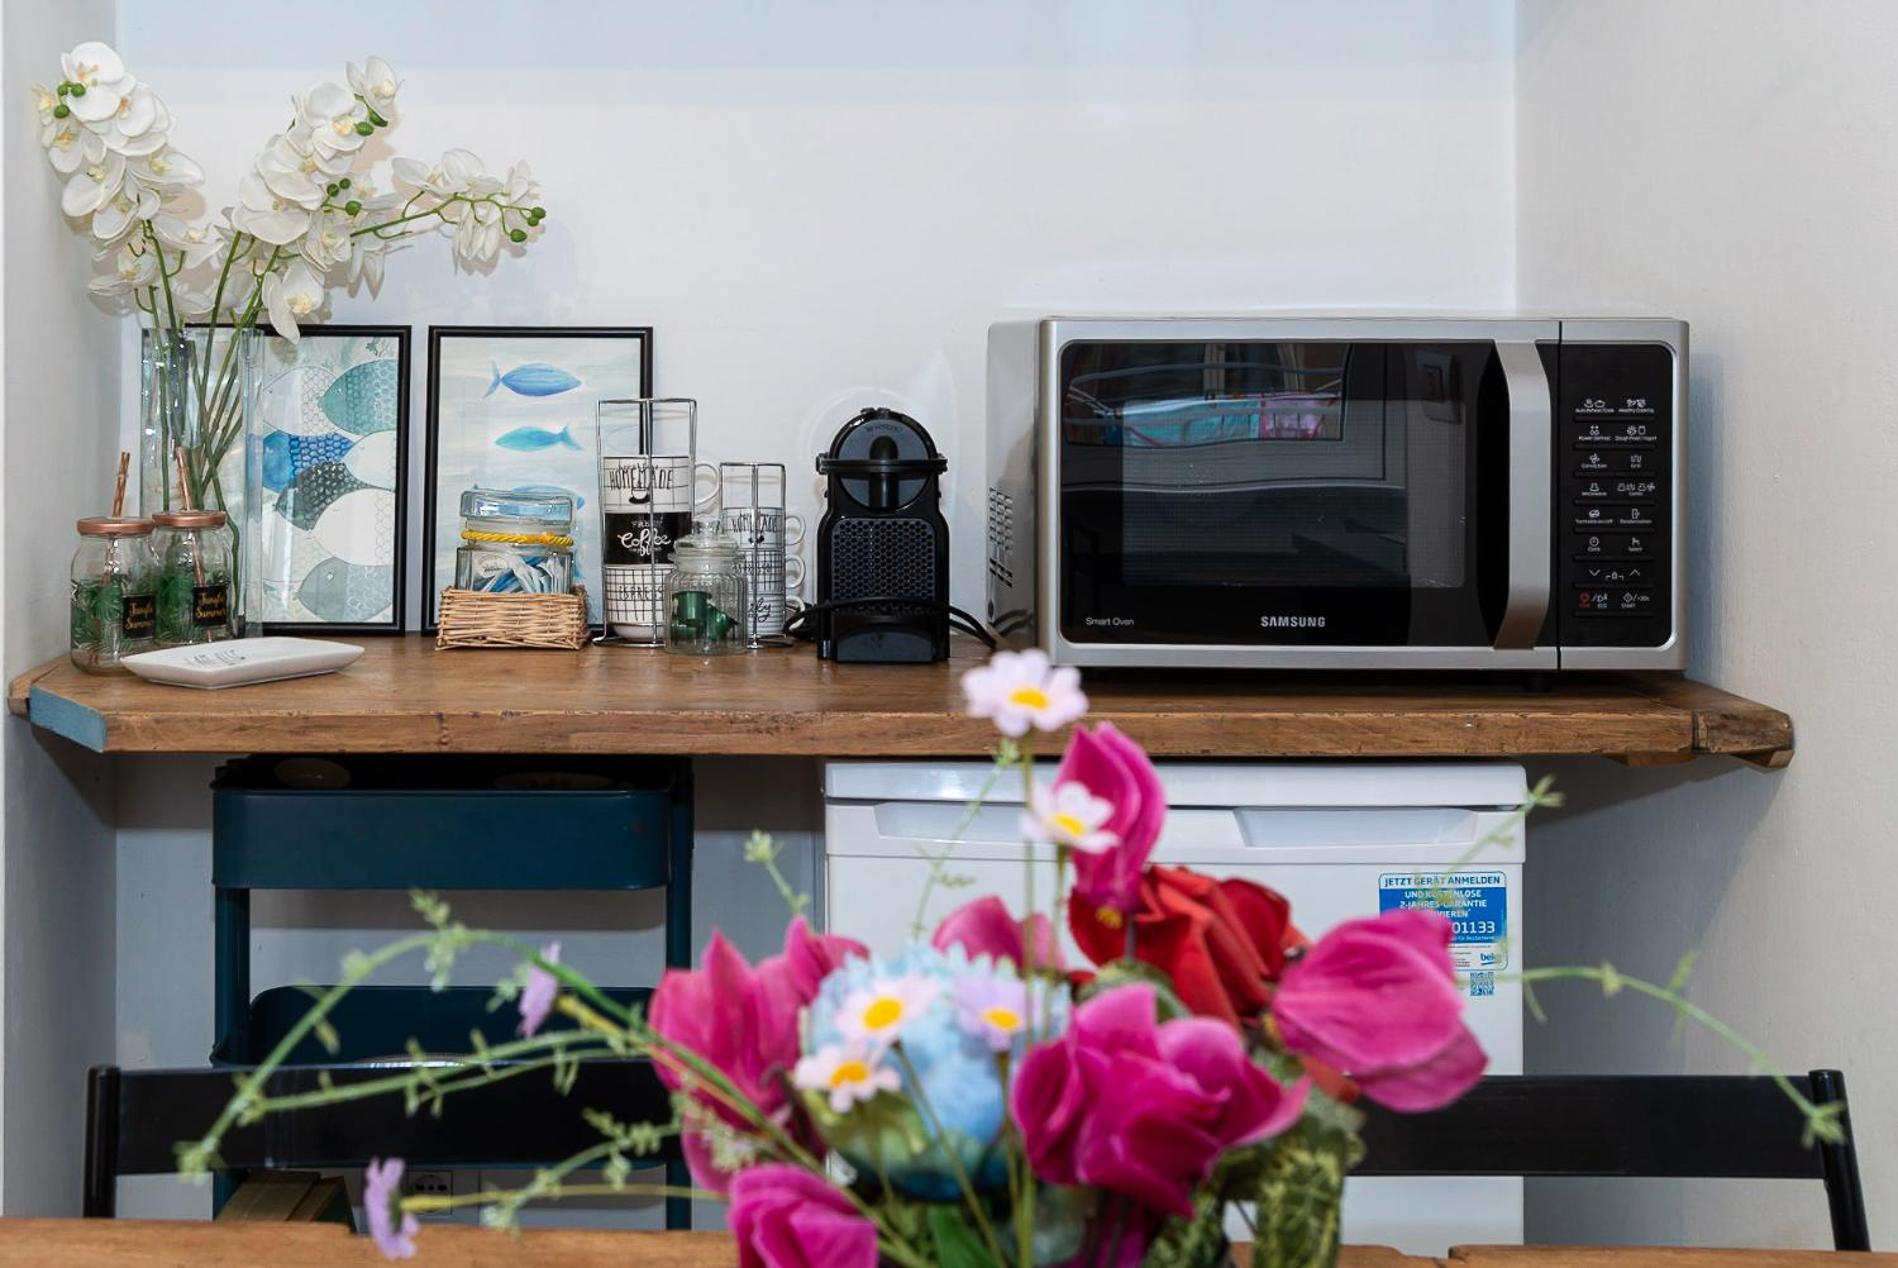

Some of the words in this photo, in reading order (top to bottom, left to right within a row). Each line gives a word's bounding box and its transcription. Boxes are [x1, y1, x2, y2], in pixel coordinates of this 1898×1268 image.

[1086, 617, 1110, 626] Smart
[1112, 617, 1135, 625] Oven
[1260, 616, 1326, 628] SAMSUNG
[1384, 878, 1411, 887] JETZT
[1448, 875, 1500, 885] ANMELDEN
[1404, 890, 1424, 899] UND
